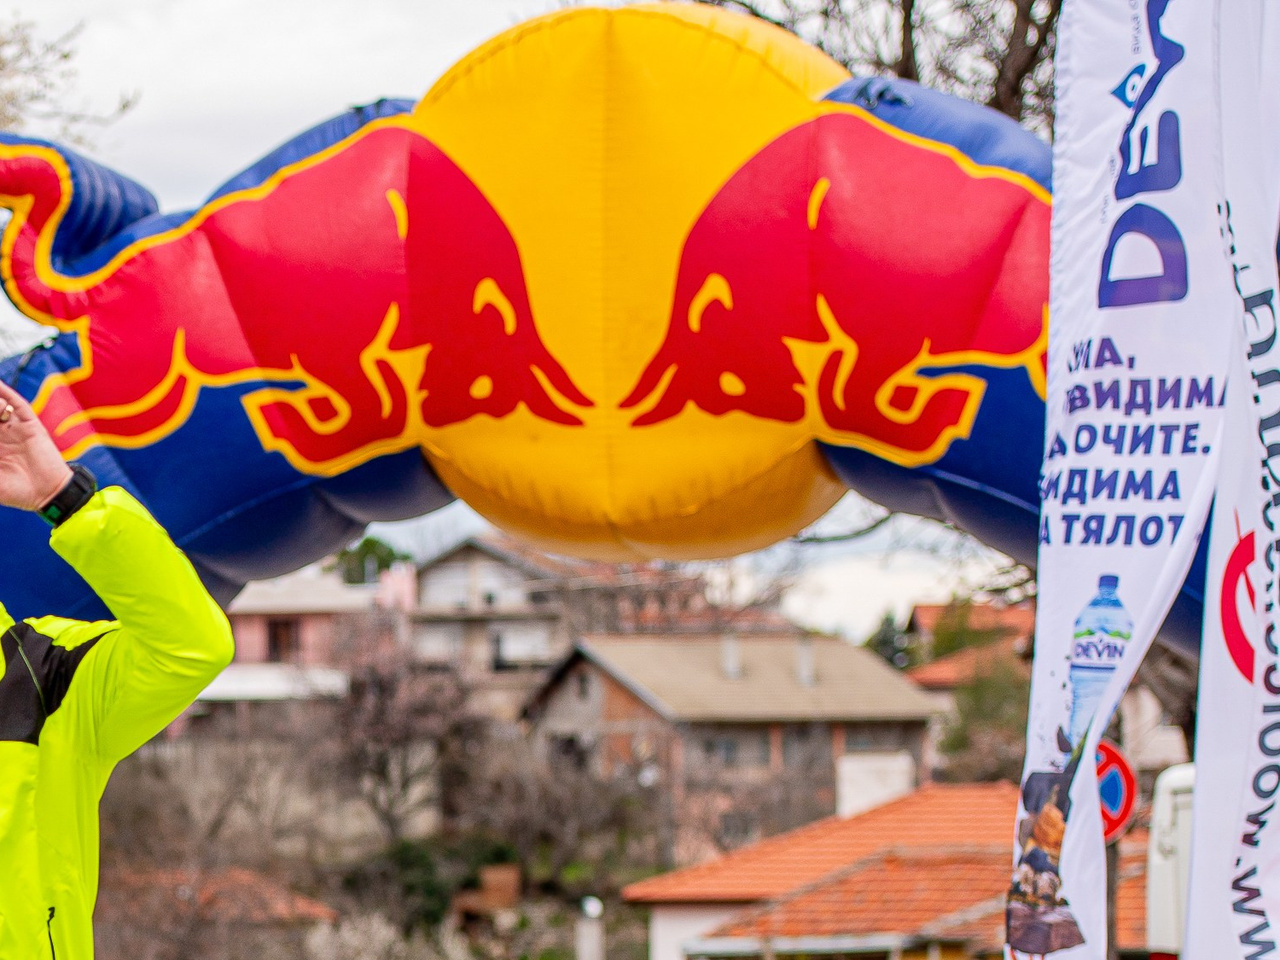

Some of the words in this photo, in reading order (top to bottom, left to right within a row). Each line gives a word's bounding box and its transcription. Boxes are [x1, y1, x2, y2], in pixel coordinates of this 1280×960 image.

[1074, 422, 1212, 456] ОЧИТЕ.
[1061, 513, 1185, 547] ТЯЛОТ
[1075, 638, 1125, 659] DEVIN
